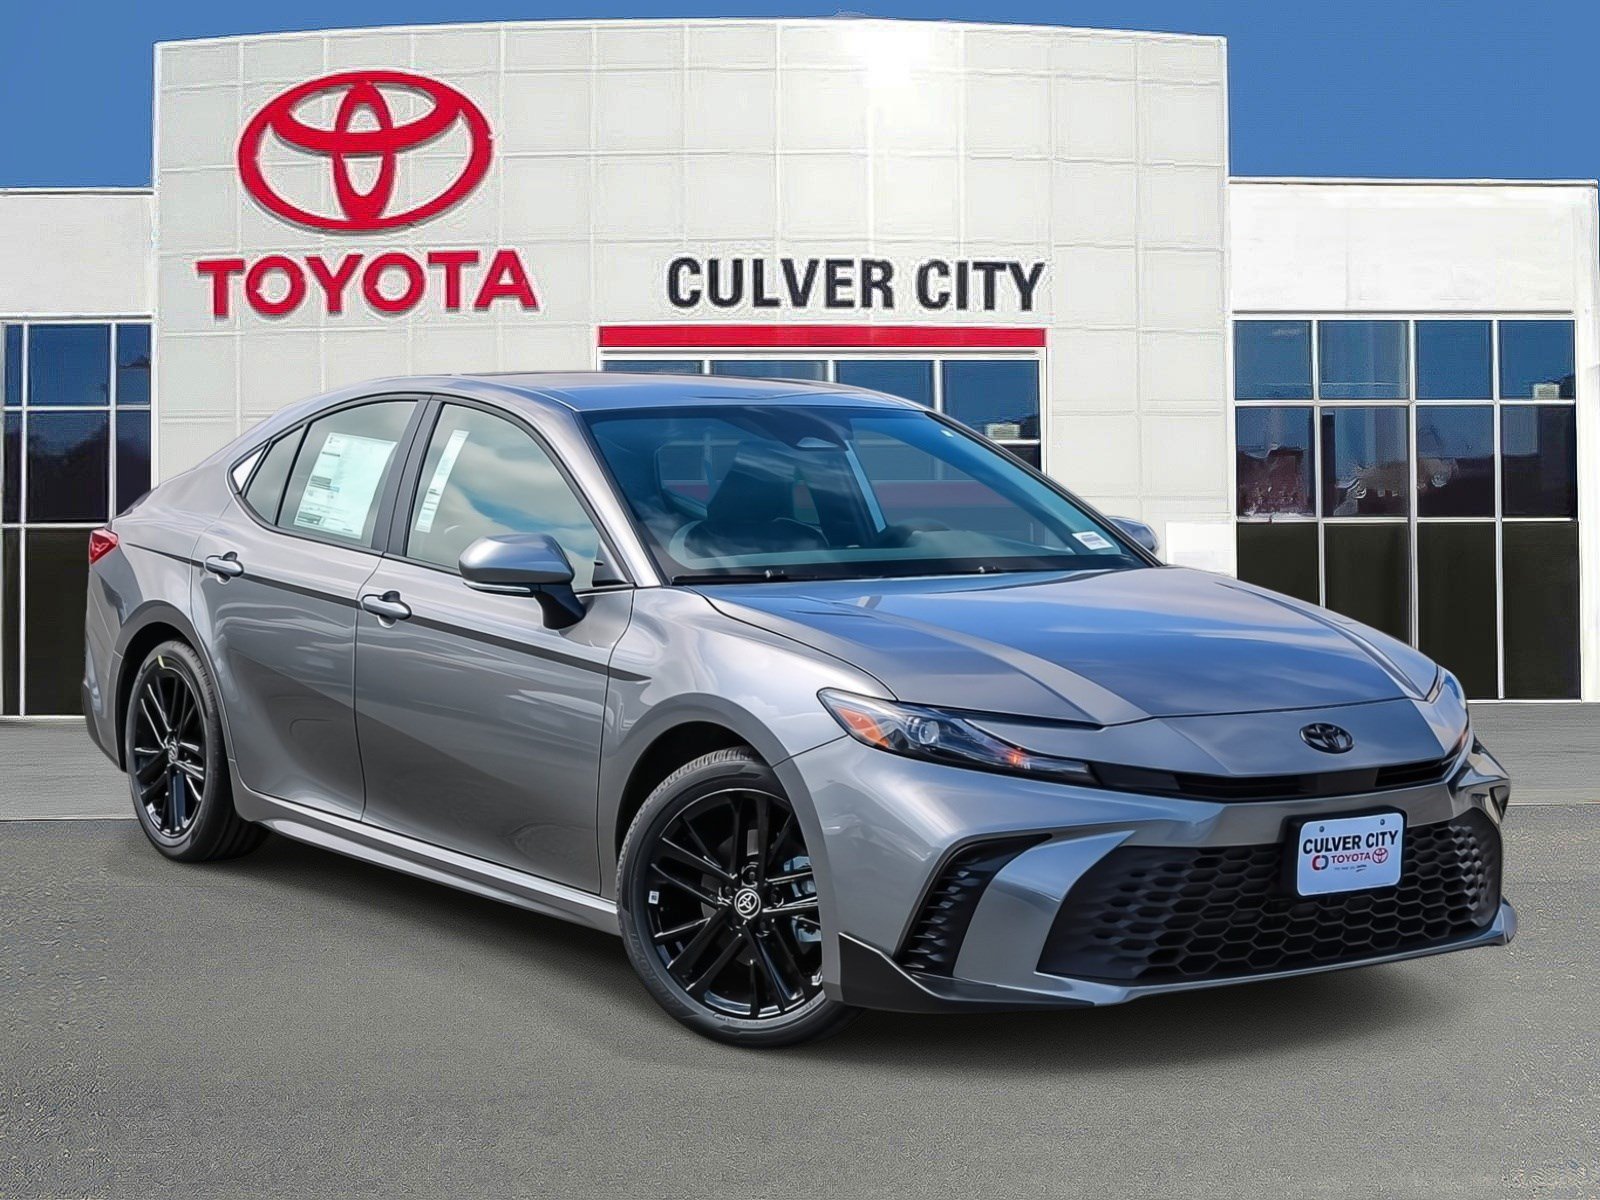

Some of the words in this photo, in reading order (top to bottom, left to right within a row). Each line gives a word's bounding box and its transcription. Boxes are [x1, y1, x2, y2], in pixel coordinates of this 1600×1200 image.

[197, 249, 539, 318] TOYOTA
[667, 257, 894, 309] CULVER
[916, 260, 1046, 311] CITY
[1303, 835, 1362, 855] CULVER
[1366, 830, 1399, 848] CITY
[1331, 852, 1371, 864] TOYOTA
